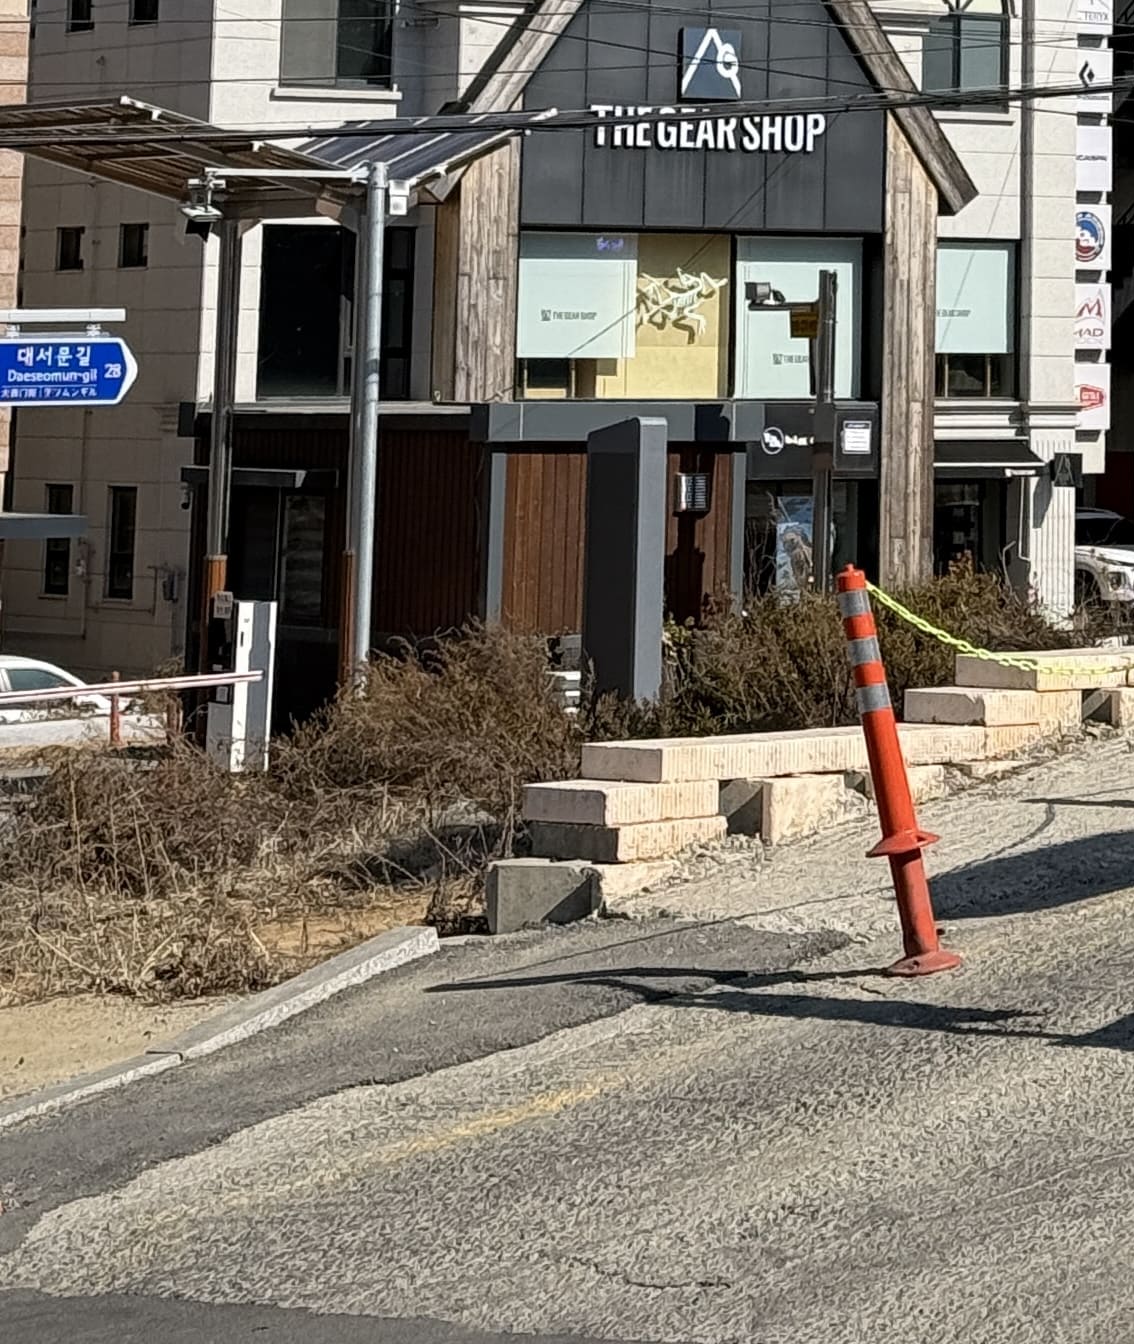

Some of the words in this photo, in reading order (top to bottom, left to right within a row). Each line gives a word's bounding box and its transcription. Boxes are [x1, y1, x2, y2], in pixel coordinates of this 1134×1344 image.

[590, 104, 651, 147] THE
[656, 107, 737, 150] GEAR
[741, 112, 826, 152] SHOP
[17, 346, 91, 367] 대서문길
[7, 369, 97, 383] Daeseomun-gil
[104, 363, 121, 379] 28
